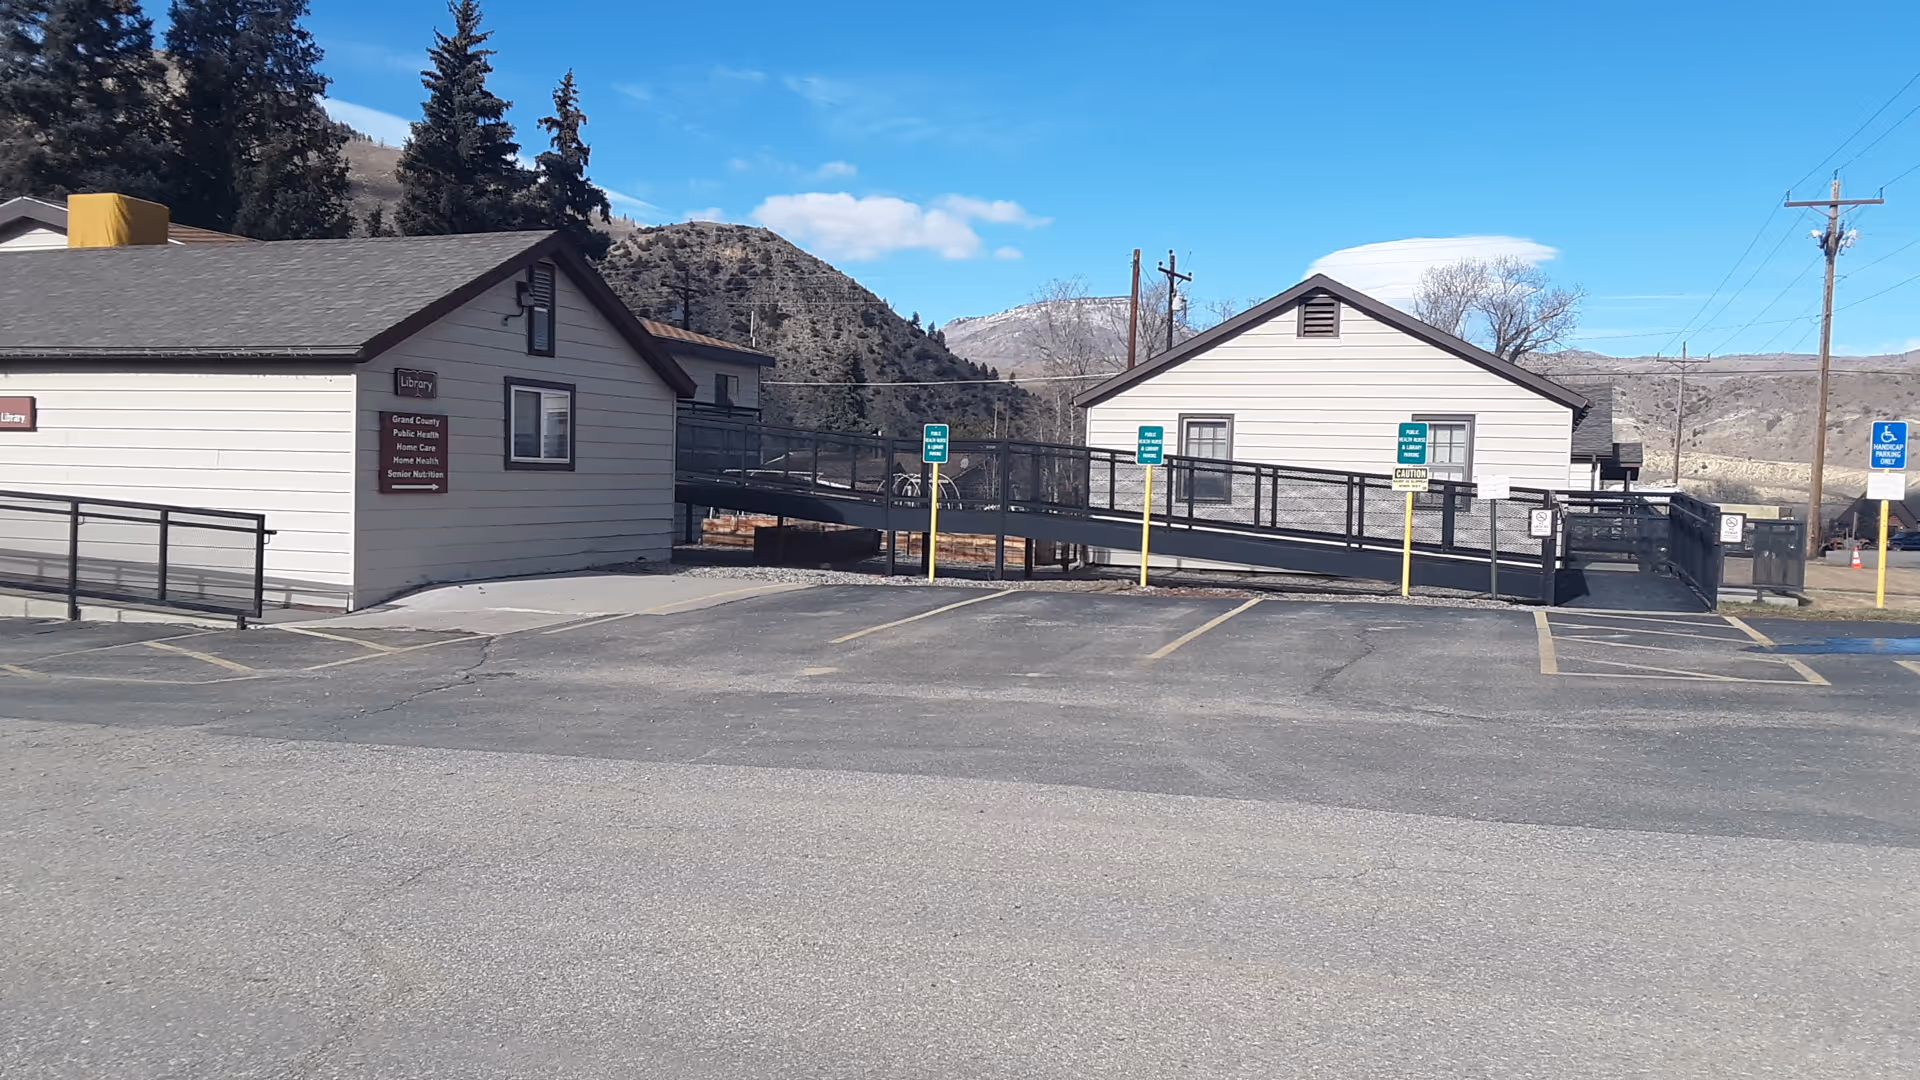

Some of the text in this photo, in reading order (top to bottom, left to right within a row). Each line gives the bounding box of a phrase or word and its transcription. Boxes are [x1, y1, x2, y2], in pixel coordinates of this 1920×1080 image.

[400, 375, 433, 392] Library
[1, 412, 26, 424] Library
[392, 415, 440, 427] Grand County
[393, 429, 440, 439] Public Health
[396, 443, 436, 452] Home Care
[1873, 443, 1904, 451] HANDICAP
[1875, 451, 1901, 459] PARKING
[393, 456, 440, 466] Home Health
[1880, 458, 1896, 466] ONLY
[387, 470, 444, 479] Senior Nutrition
[1396, 469, 1427, 478] CAUTION
